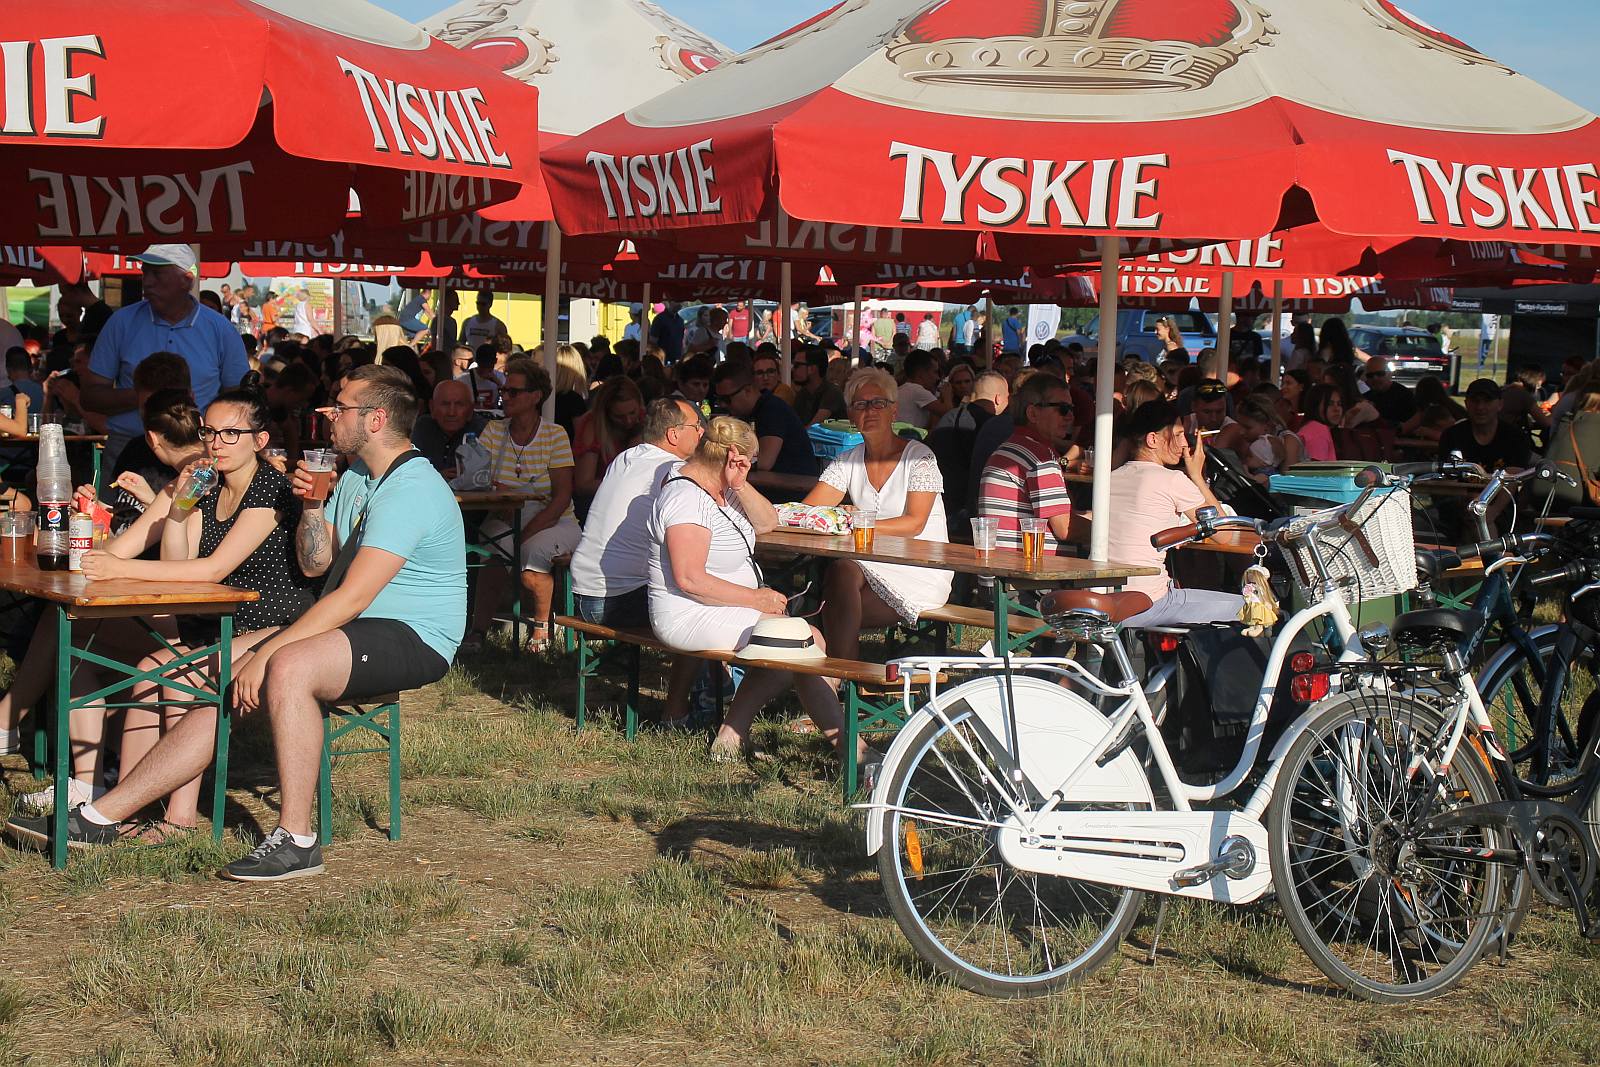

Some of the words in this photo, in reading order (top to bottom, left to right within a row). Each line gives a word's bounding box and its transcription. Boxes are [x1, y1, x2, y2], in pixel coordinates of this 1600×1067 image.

[336, 55, 512, 169] TYSKIE
[585, 138, 722, 219] TYSKIE
[889, 140, 1170, 230] TYSKIE
[1386, 148, 1600, 234] TYSKIE
[1119, 232, 1284, 268] SKIE
